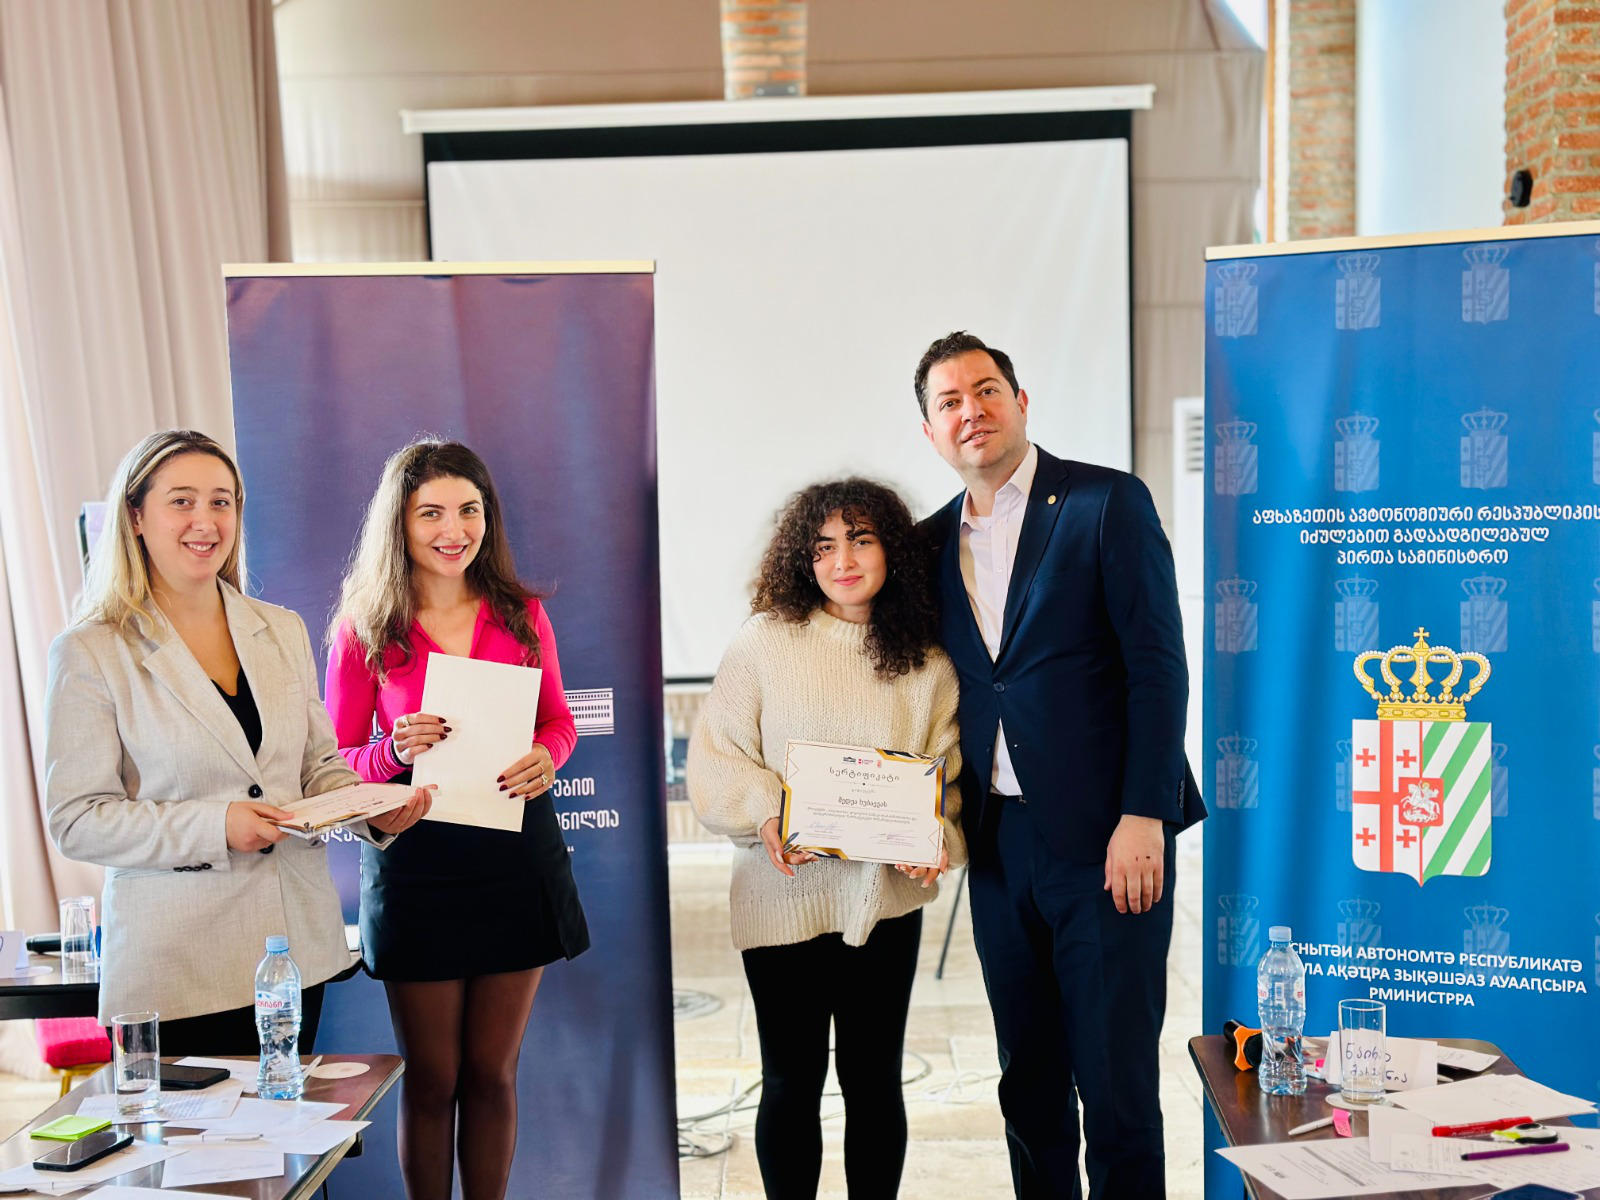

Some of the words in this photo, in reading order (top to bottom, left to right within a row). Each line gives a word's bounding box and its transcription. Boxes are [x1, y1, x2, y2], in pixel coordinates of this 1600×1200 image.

[1252, 508, 1345, 524] აფხაზეთის
[1349, 505, 1473, 523] ავტონომიური
[1300, 529, 1389, 544] იძულებით
[1393, 527, 1550, 544] გადაადგილებულ
[1336, 550, 1394, 565] პირთა
[1397, 548, 1509, 565] სამინისტრო
[552, 777, 595, 797] ებით
[1291, 941, 1352, 958] СНЫТӘИ
[1356, 946, 1455, 965] АВТОНОМТӘ
[1459, 952, 1582, 973] РЕСПУБЛИКАТӘ
[1304, 962, 1324, 976] ЛА
[1369, 987, 1475, 1007] РМИНИСТРРА
